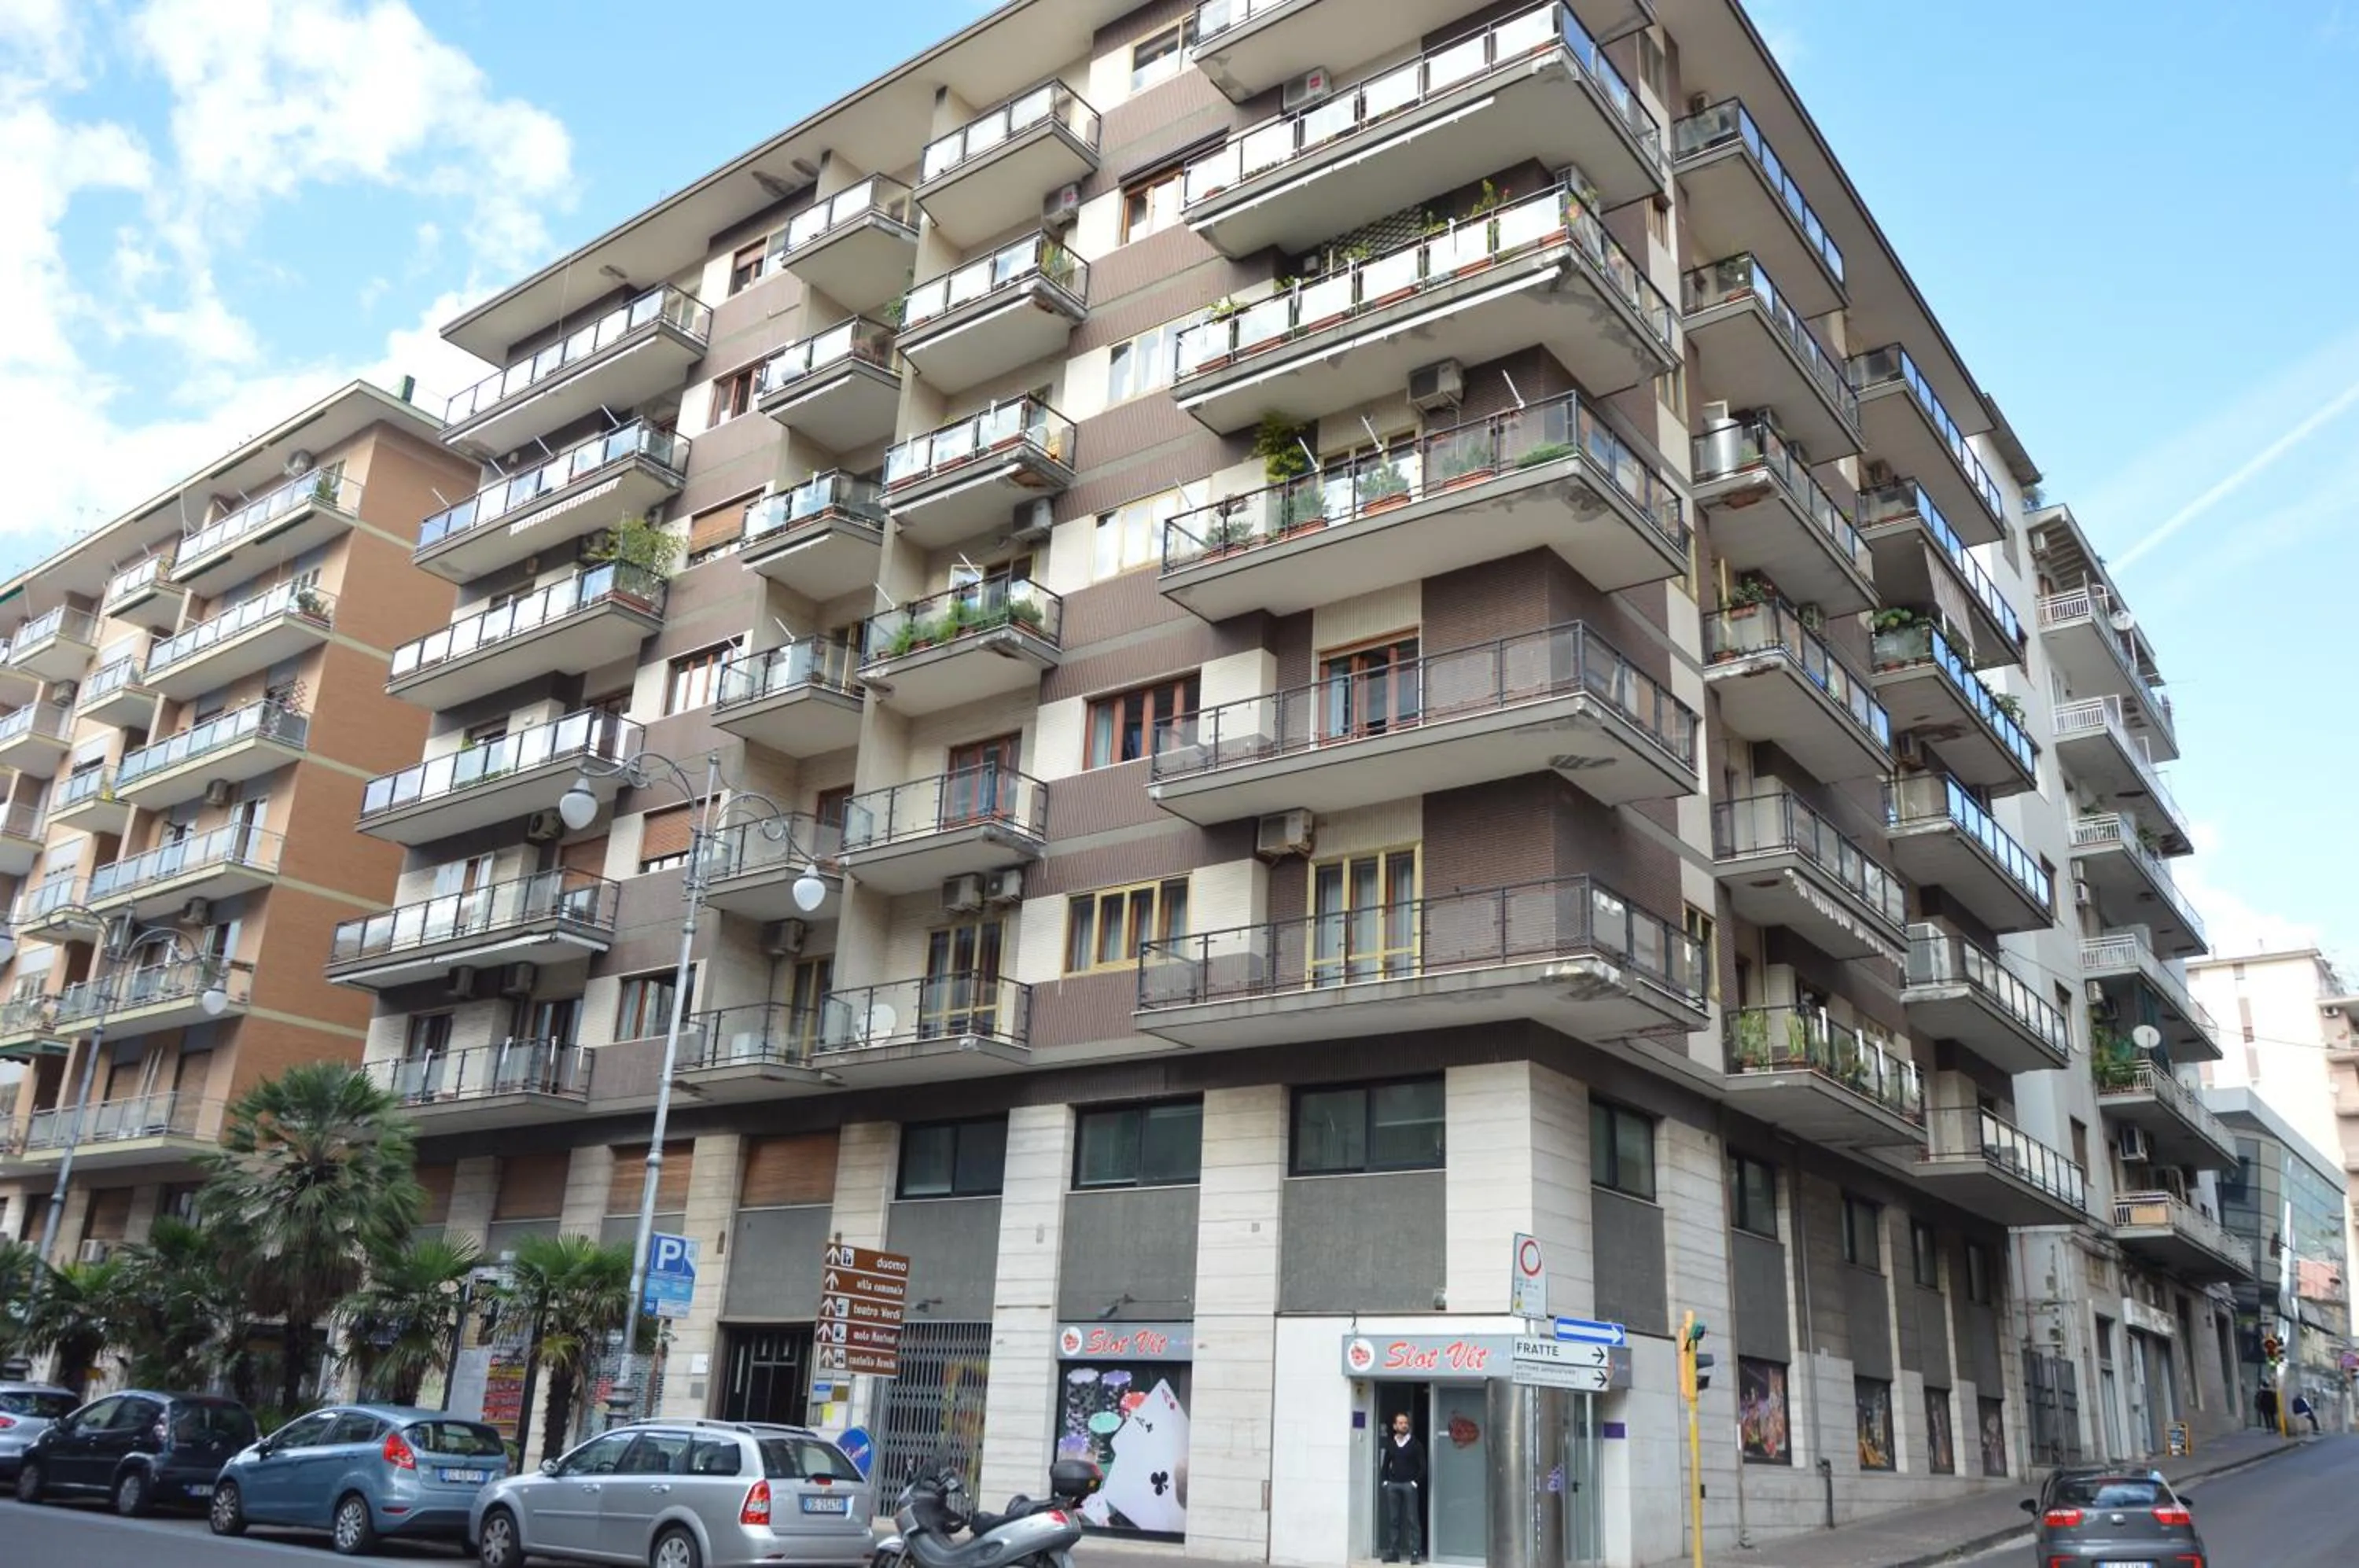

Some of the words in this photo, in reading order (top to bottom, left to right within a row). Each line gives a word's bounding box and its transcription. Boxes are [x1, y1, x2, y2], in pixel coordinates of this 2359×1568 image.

[657, 1239, 683, 1270] P
[876, 1257, 907, 1272] duomo
[1084, 1327, 1130, 1355] Slot
[1382, 1340, 1439, 1371] Slot
[1444, 1339, 1491, 1371] Vit
[1516, 1342, 1560, 1356] FRATTE
